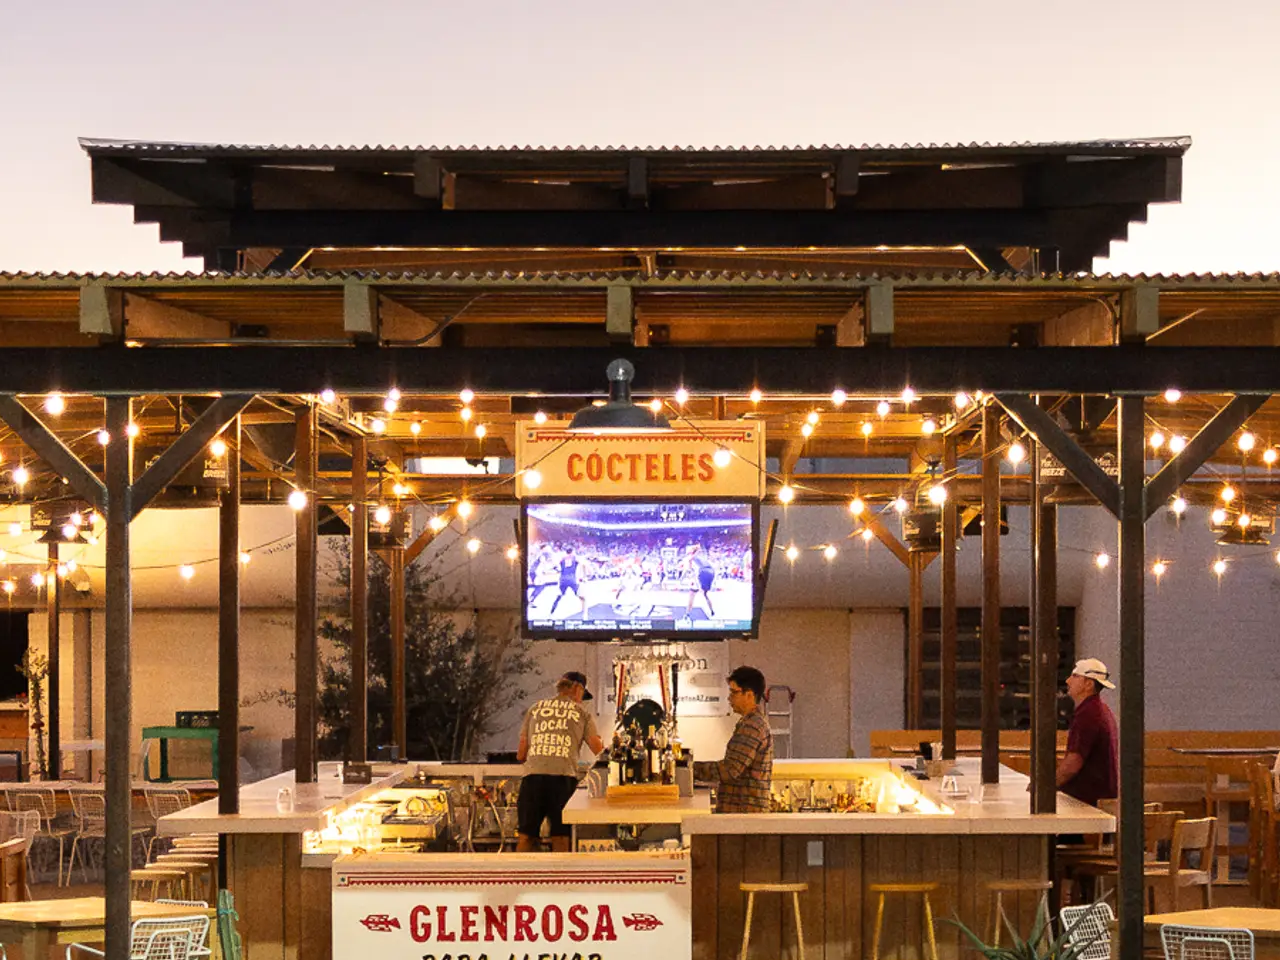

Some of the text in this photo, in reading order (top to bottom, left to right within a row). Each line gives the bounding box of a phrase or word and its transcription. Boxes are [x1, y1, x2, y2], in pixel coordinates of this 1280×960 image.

[566, 448, 716, 483] CÓCTELES
[536, 699, 577, 710] THANK
[531, 708, 580, 722] YOUR
[534, 719, 569, 733] LOCAL
[530, 733, 572, 747] GREENS
[529, 745, 570, 758] KEEPER
[409, 904, 617, 943] GLENROSA
